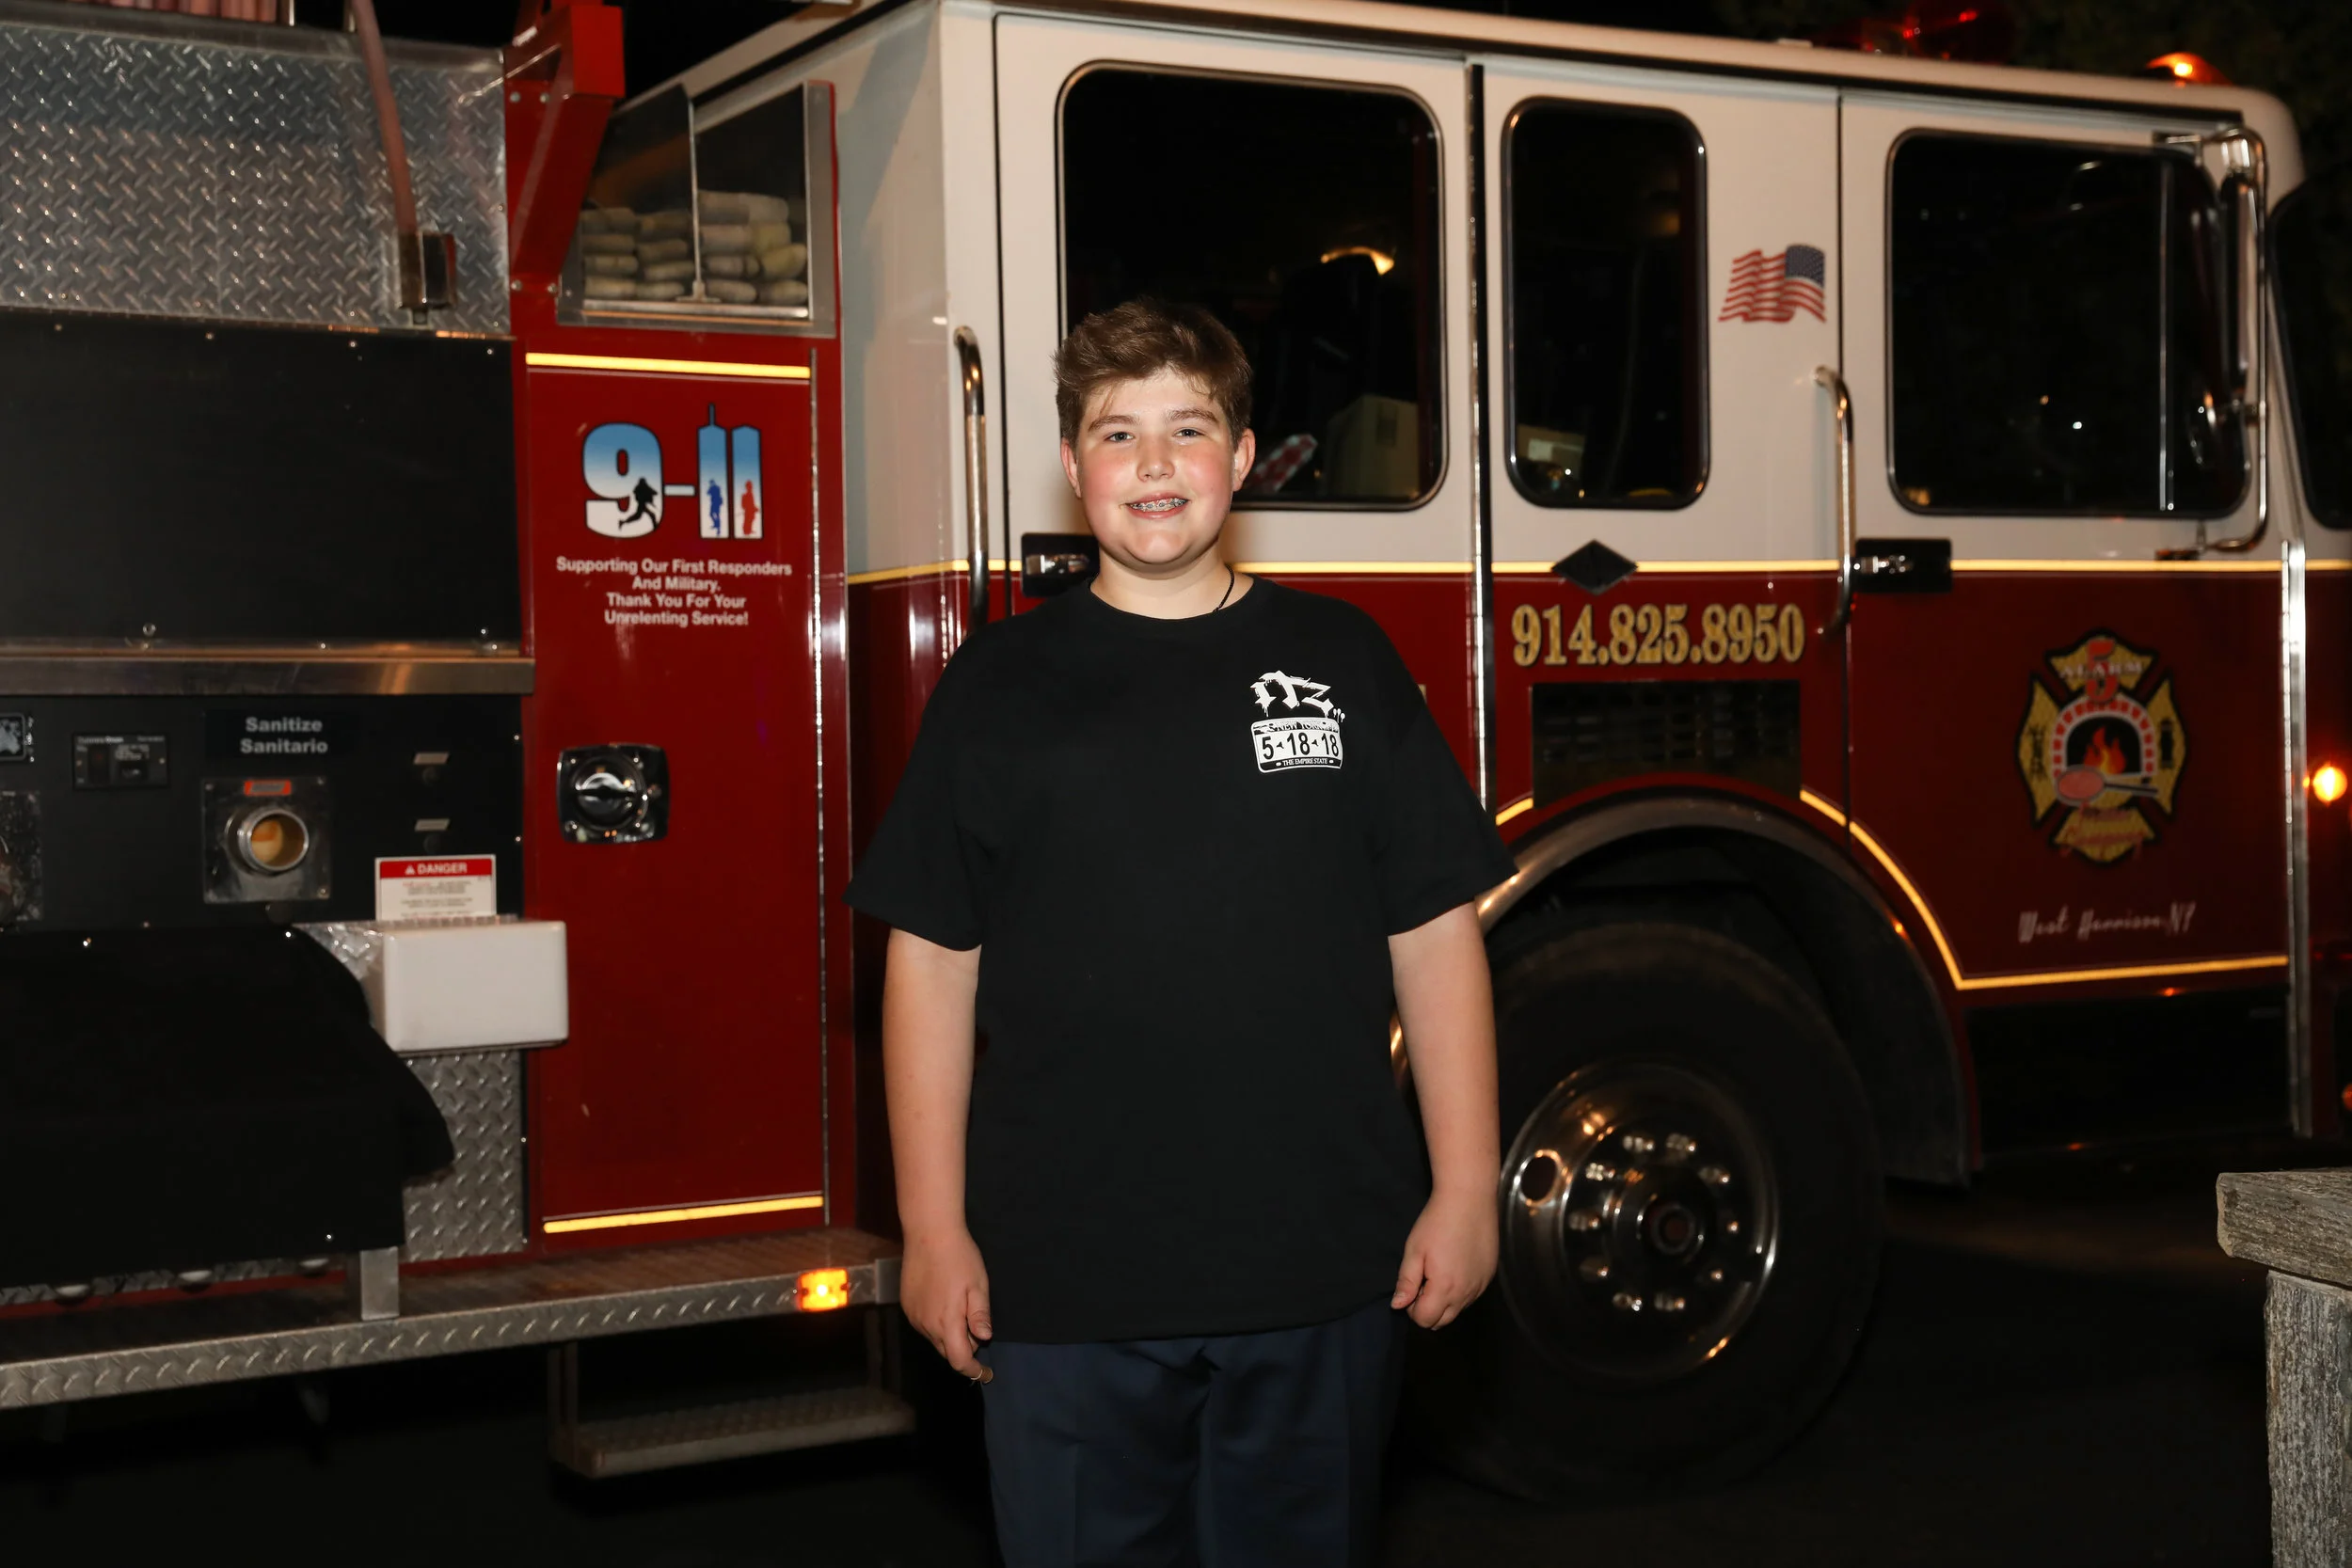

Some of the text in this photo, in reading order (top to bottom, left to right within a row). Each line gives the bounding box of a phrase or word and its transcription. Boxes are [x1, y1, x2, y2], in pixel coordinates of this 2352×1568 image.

[556, 557, 792, 577] Supporting Our First Responders
[632, 577, 722, 593] And Military.
[606, 592, 747, 609] Thank You For Your
[605, 610, 749, 628] Unrelenting Service!
[1511, 602, 1805, 667] 914.825.8950
[2086, 639, 2119, 704] 5
[245, 716, 324, 733] Sanitize
[240, 737, 329, 754] Sanitario
[417, 862, 469, 875] DANGER
[2017, 902, 2072, 944] West
